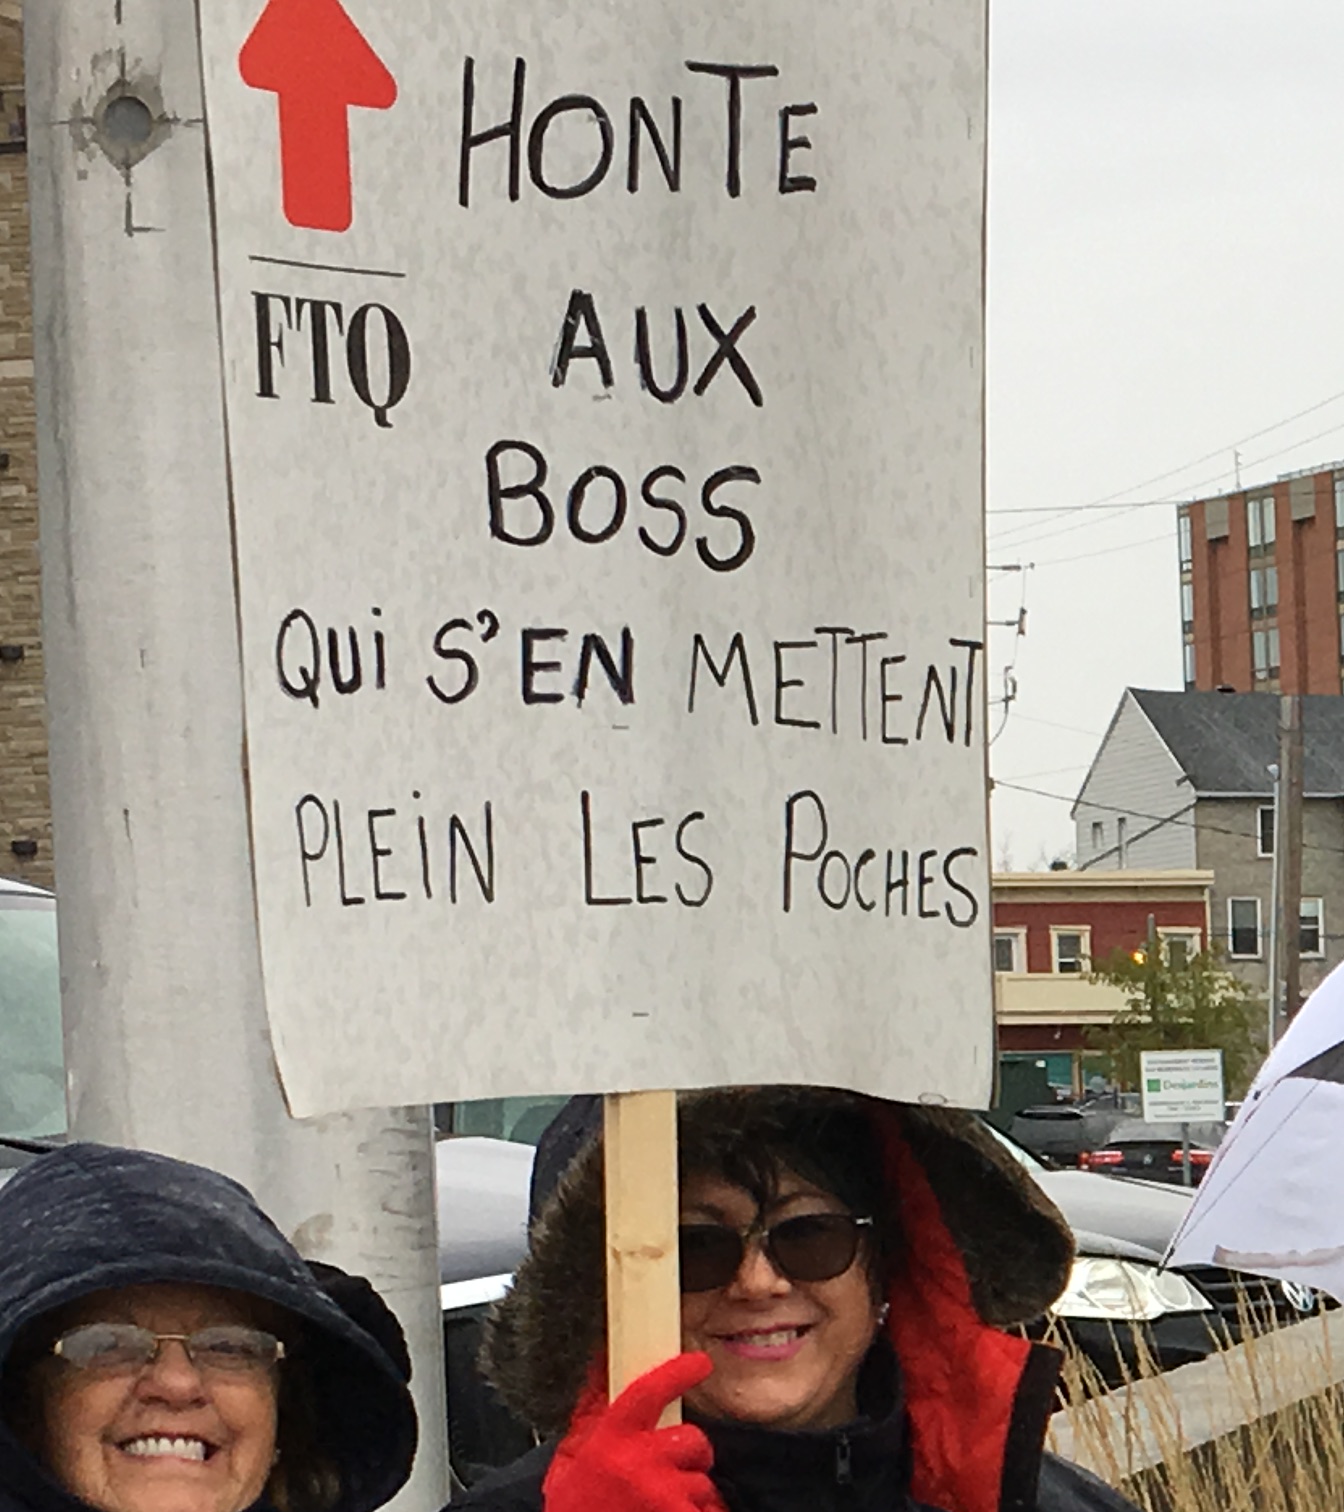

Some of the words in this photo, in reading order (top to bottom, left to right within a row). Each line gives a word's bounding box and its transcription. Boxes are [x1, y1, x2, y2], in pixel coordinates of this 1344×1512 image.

[459, 57, 819, 207] HONTE
[251, 291, 412, 427] FTQ
[550, 289, 763, 406] AUX
[485, 440, 762, 571] BOSS
[687, 627, 984, 746] METTENT
[582, 791, 714, 906] LES
[782, 790, 979, 927] POCHES
